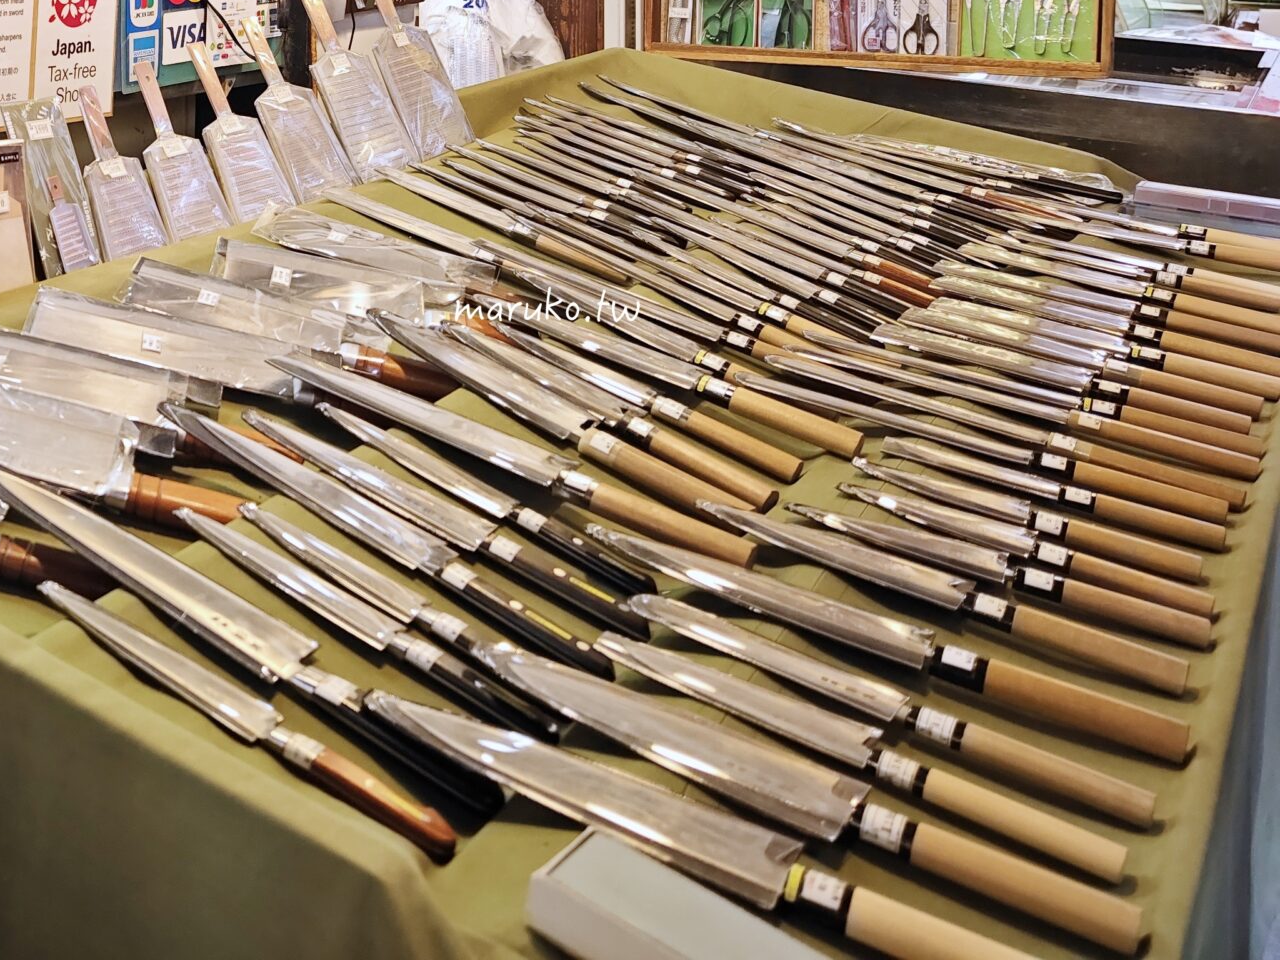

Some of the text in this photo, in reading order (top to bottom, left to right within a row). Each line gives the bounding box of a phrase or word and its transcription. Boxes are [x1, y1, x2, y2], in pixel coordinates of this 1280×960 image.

[0, 33, 22, 41] sharpens
[166, 21, 206, 50] VISA
[51, 38, 96, 59] Japan.
[47, 63, 97, 83] Tax-free
[56, 86, 81, 105] Sho
